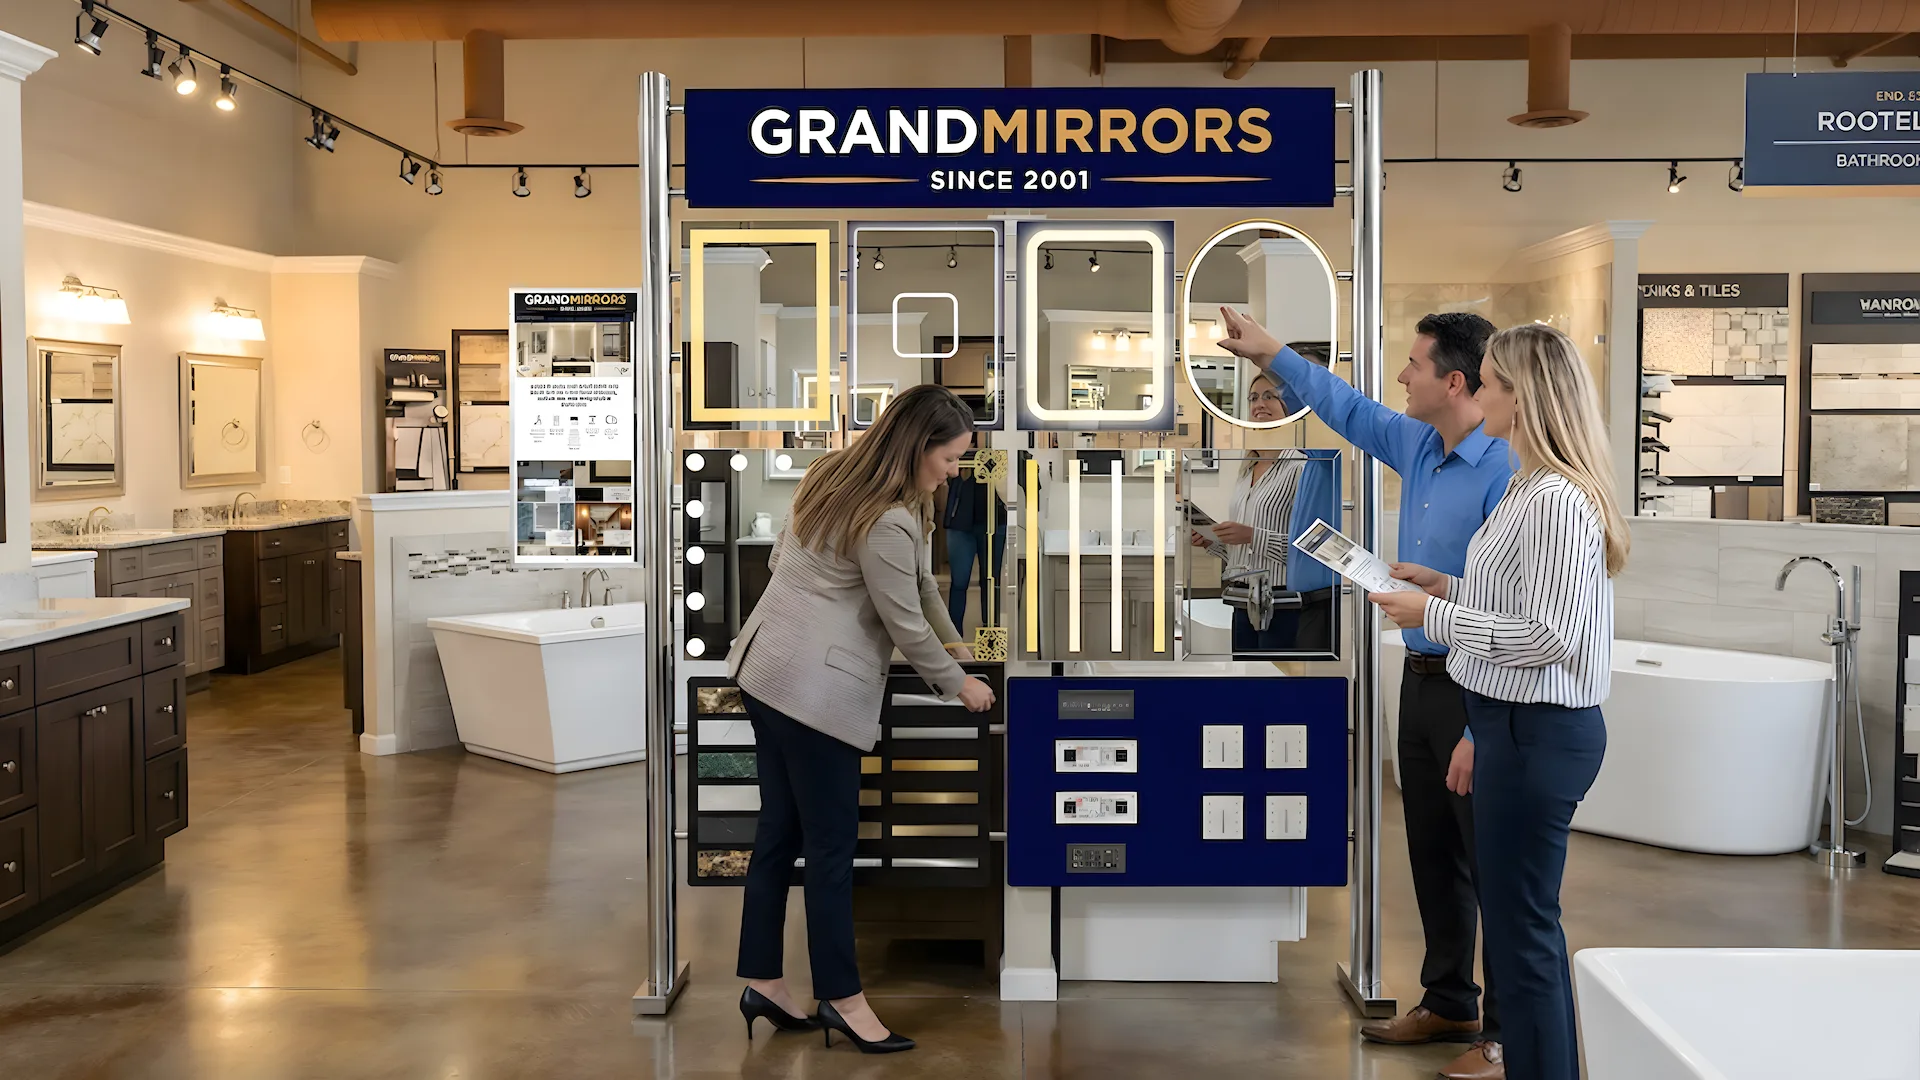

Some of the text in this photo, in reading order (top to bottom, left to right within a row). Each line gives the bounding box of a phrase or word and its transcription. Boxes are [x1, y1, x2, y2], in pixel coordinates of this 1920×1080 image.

[749, 106, 1274, 156] GRANDMIRRORS
[930, 169, 1090, 191] SINCE 2001
[524, 294, 627, 305] GRANDMIRRORS
[1684, 284, 1695, 298] &
[1699, 284, 1741, 298] TILES
